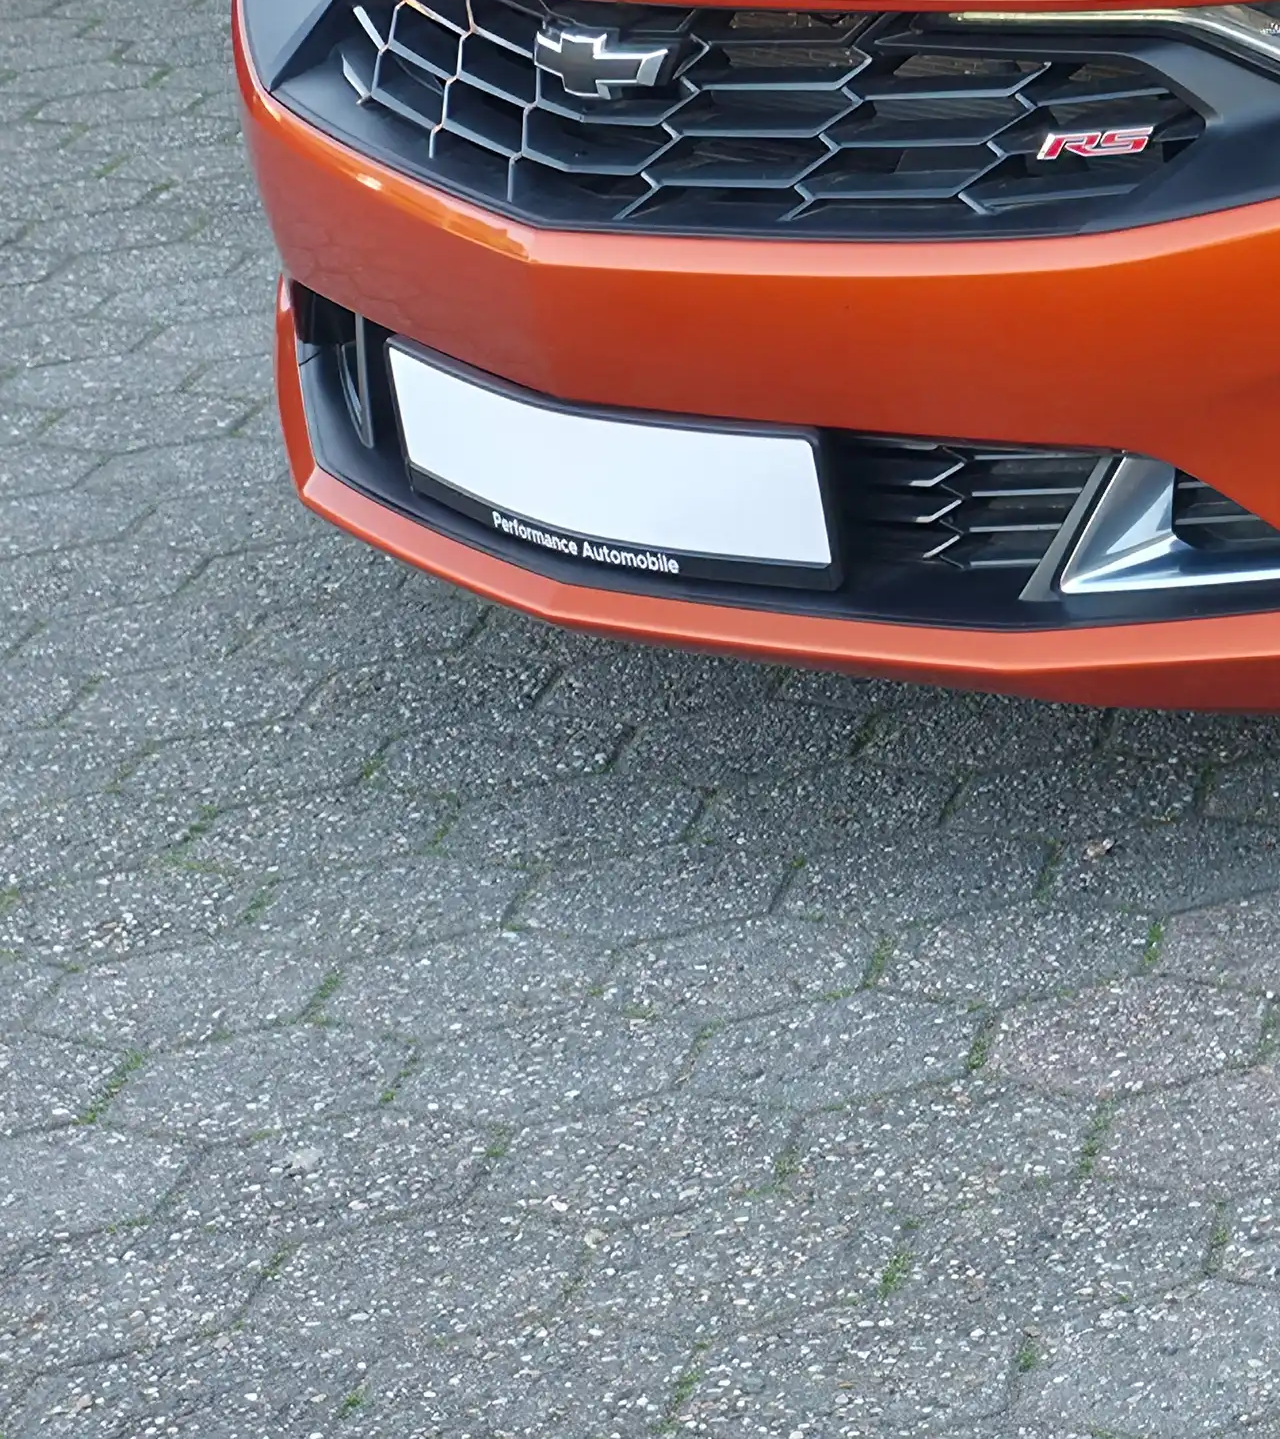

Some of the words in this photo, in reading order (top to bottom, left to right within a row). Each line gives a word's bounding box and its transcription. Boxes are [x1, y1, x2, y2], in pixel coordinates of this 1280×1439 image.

[1036, 126, 1154, 160] RS
[492, 511, 578, 556] Performance
[582, 541, 680, 574] Automobile
